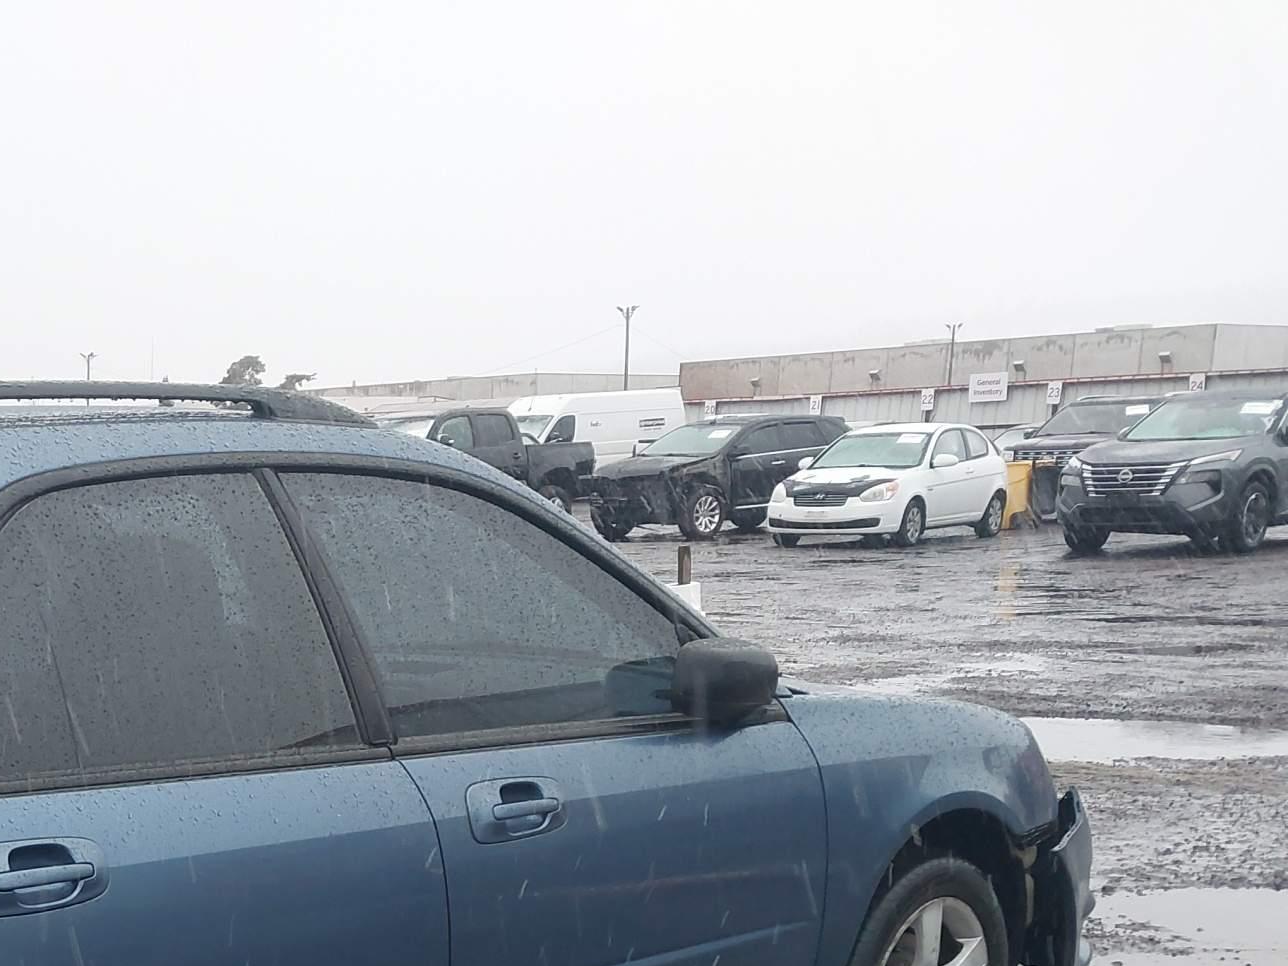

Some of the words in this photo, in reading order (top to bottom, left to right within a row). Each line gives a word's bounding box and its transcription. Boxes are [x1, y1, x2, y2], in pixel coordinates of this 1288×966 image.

[1191, 380, 1203, 391] 24
[1047, 387, 1060, 397] 23
[922, 394, 933, 405] 22
[811, 400, 820, 410] 21
